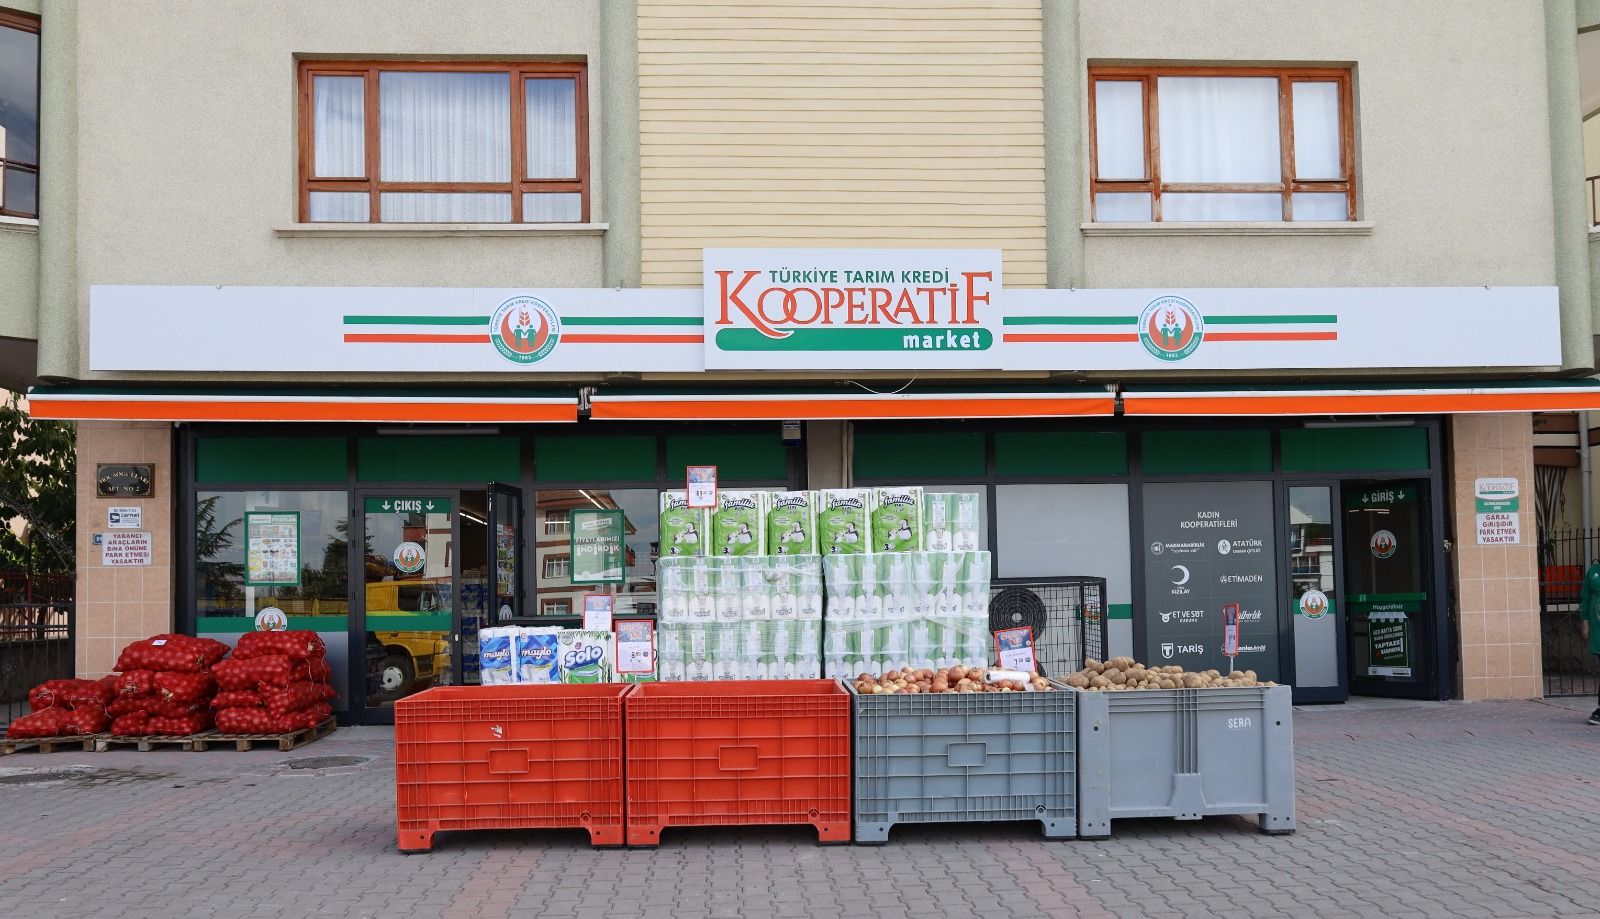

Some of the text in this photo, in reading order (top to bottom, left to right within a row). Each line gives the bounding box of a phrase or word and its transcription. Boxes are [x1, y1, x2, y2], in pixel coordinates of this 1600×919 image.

[769, 266, 949, 283] TÜRKİYE TARIM KREDİ
[714, 270, 993, 339] KOOPERATİF
[903, 329, 980, 349] market
[884, 495, 915, 508] familia
[1371, 490, 1394, 504] GİRİŞ
[394, 500, 422, 513] ÇIKIŞ
[724, 498, 755, 512] familia
[776, 497, 807, 511] familia
[831, 498, 862, 511] familia
[1180, 519, 1238, 529] KOOPERATİFLERİ
[1233, 539, 1262, 547] ATATÜRK
[1177, 644, 1204, 654] TARİŞ
[1228, 717, 1251, 728] SERA
